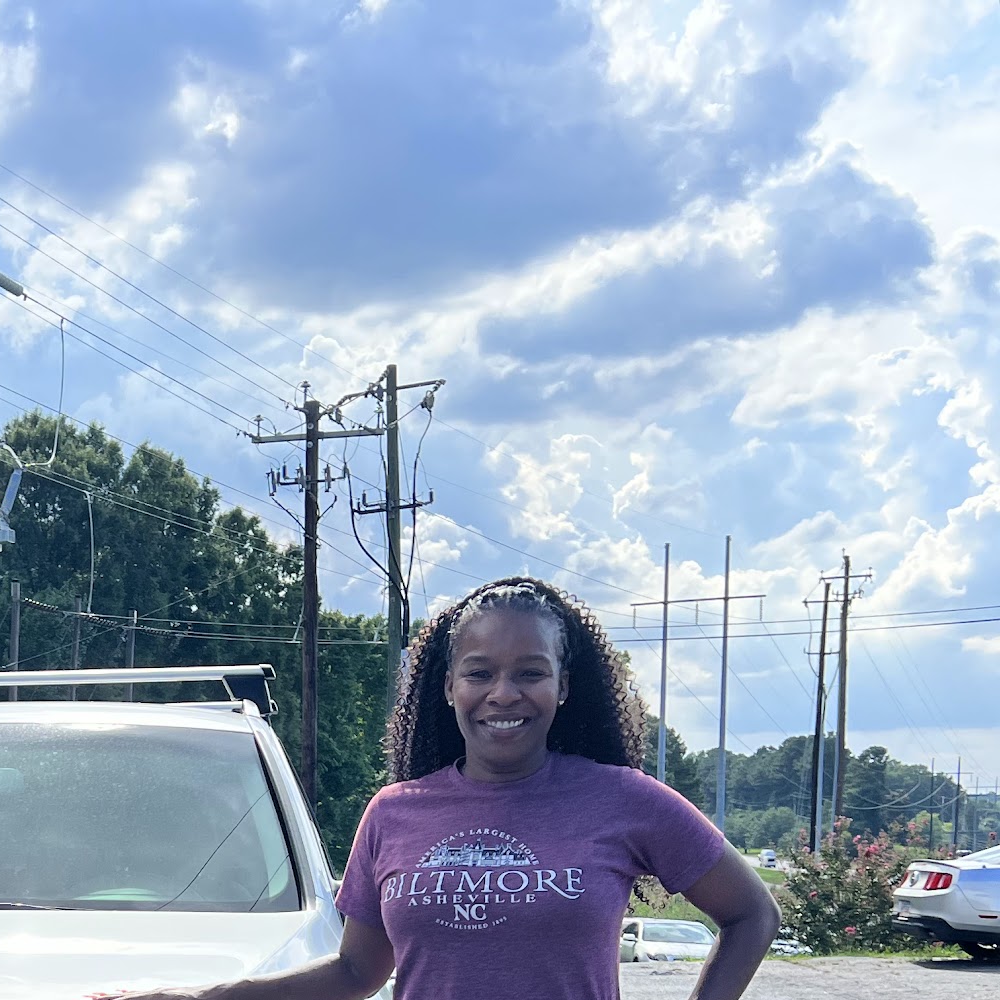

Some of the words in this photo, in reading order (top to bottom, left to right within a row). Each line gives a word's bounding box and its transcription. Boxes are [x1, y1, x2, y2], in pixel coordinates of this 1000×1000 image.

[469, 828, 517, 843] LARGEST
[518, 843, 540, 866] HOME
[383, 867, 587, 903] BILTMORE
[408, 893, 537, 907] ASHEVILLE
[454, 903, 487, 921] NC
[435, 918, 489, 930] ESTABLISHED
